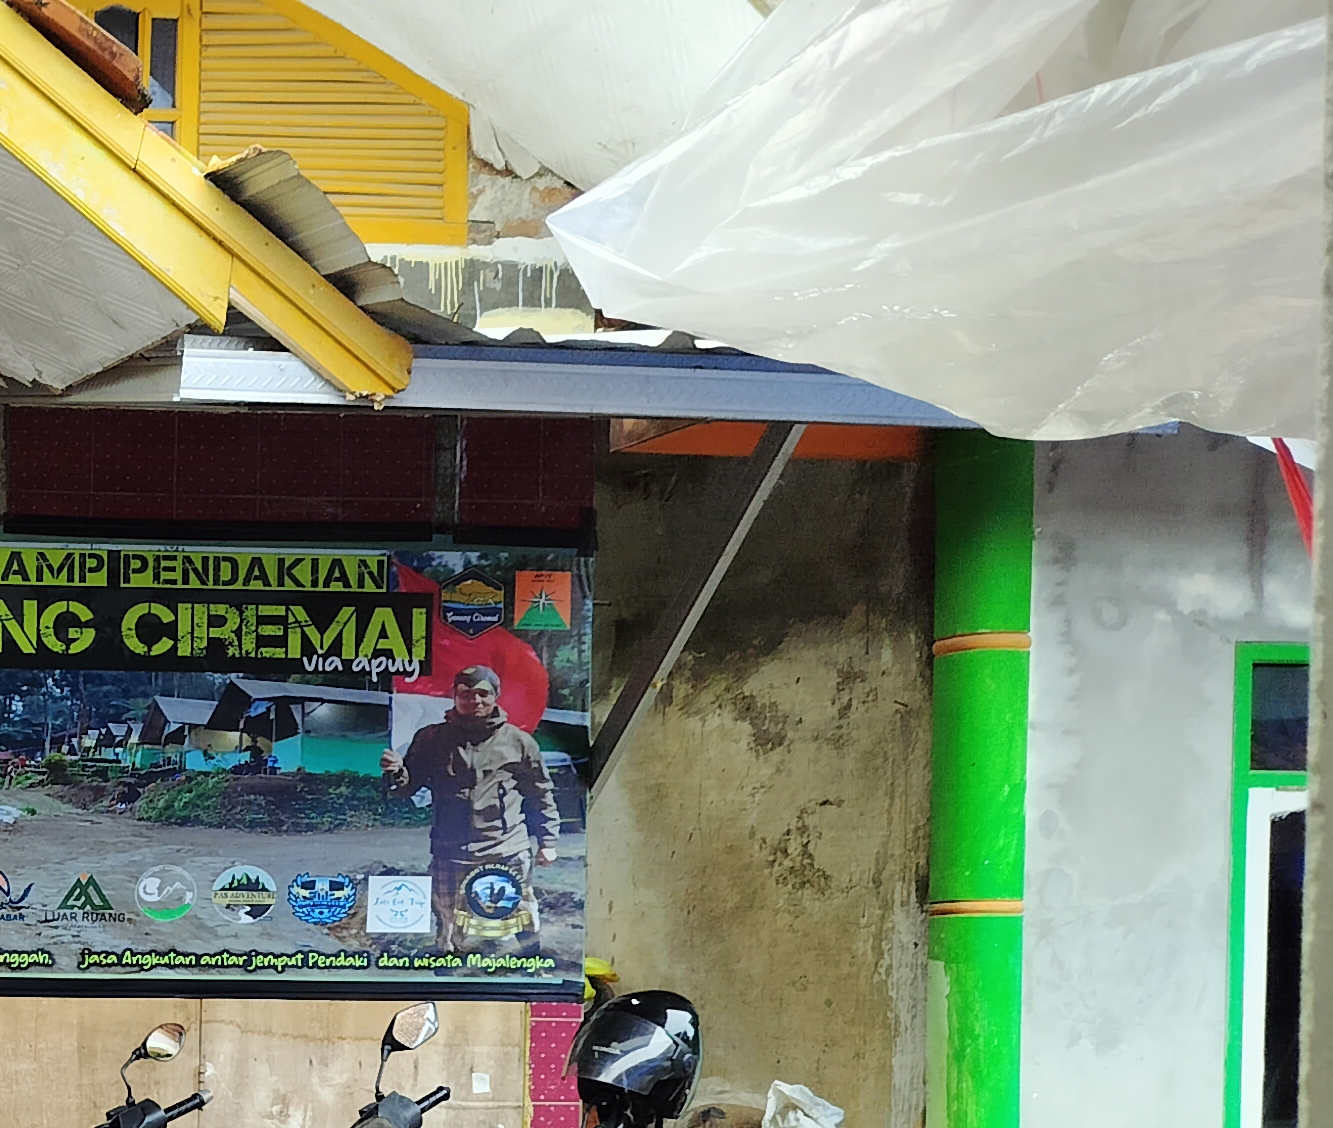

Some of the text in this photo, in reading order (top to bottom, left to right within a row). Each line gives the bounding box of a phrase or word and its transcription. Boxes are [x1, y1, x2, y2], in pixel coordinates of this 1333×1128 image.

[122, 552, 386, 590] PENDAKIAN
[121, 601, 427, 661] CIREMAI
[302, 653, 421, 682] via apuy
[80, 951, 119, 969] jasa
[122, 950, 196, 971] Angkutan
[200, 952, 245, 967] antar
[247, 952, 305, 973] jemput
[307, 951, 368, 969] Pendaki
[378, 953, 410, 968] dan
[413, 954, 463, 970] wisata
[466, 954, 556, 975] Majalengka
